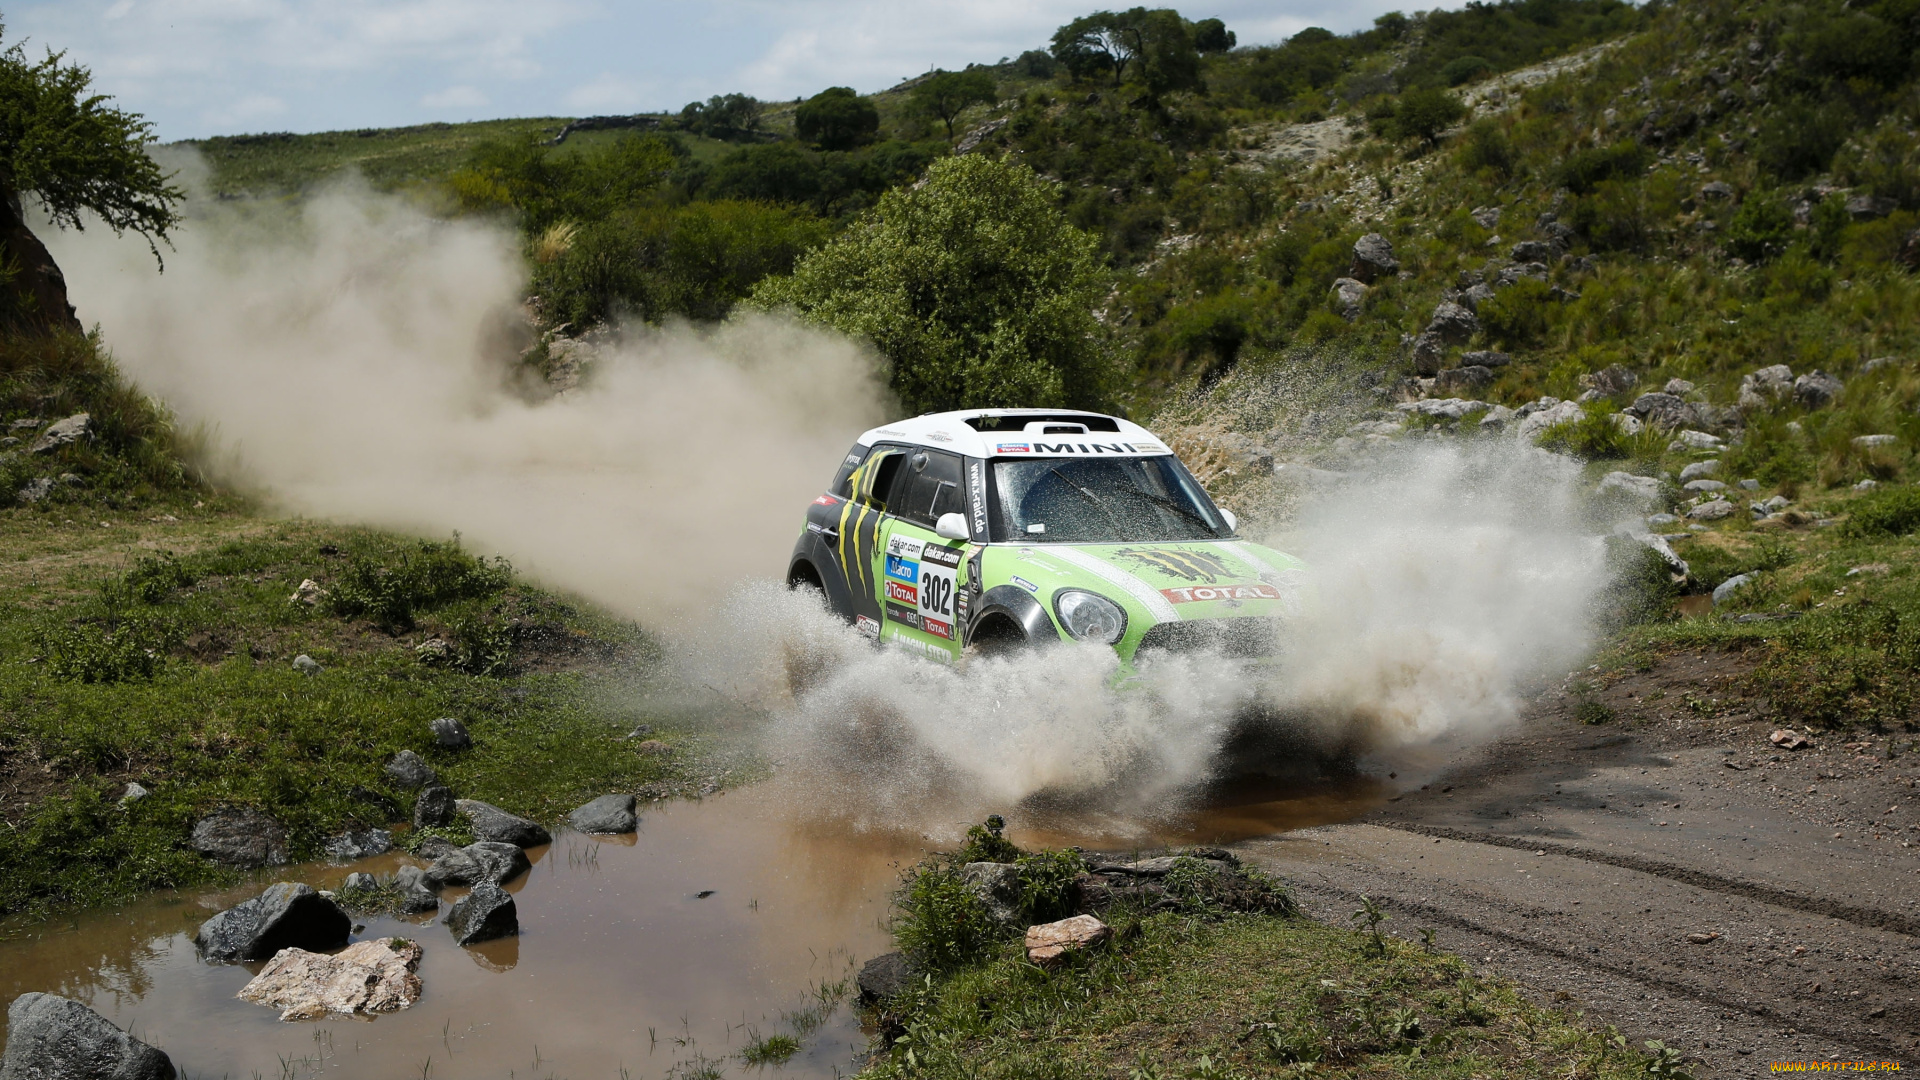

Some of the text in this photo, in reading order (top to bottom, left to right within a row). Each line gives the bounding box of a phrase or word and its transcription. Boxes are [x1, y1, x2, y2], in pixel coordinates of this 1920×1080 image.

[1033, 443, 1137, 453] MINI
[970, 462, 984, 534] www.x-raid.de
[889, 537, 921, 554] dakar.com
[923, 545, 960, 564] dakar.com
[890, 560, 912, 578] Macro
[892, 583, 917, 603] TOTAL
[922, 572, 950, 616] 302
[1170, 587, 1275, 601] TOTAL
[925, 619, 948, 636] TOTAL
